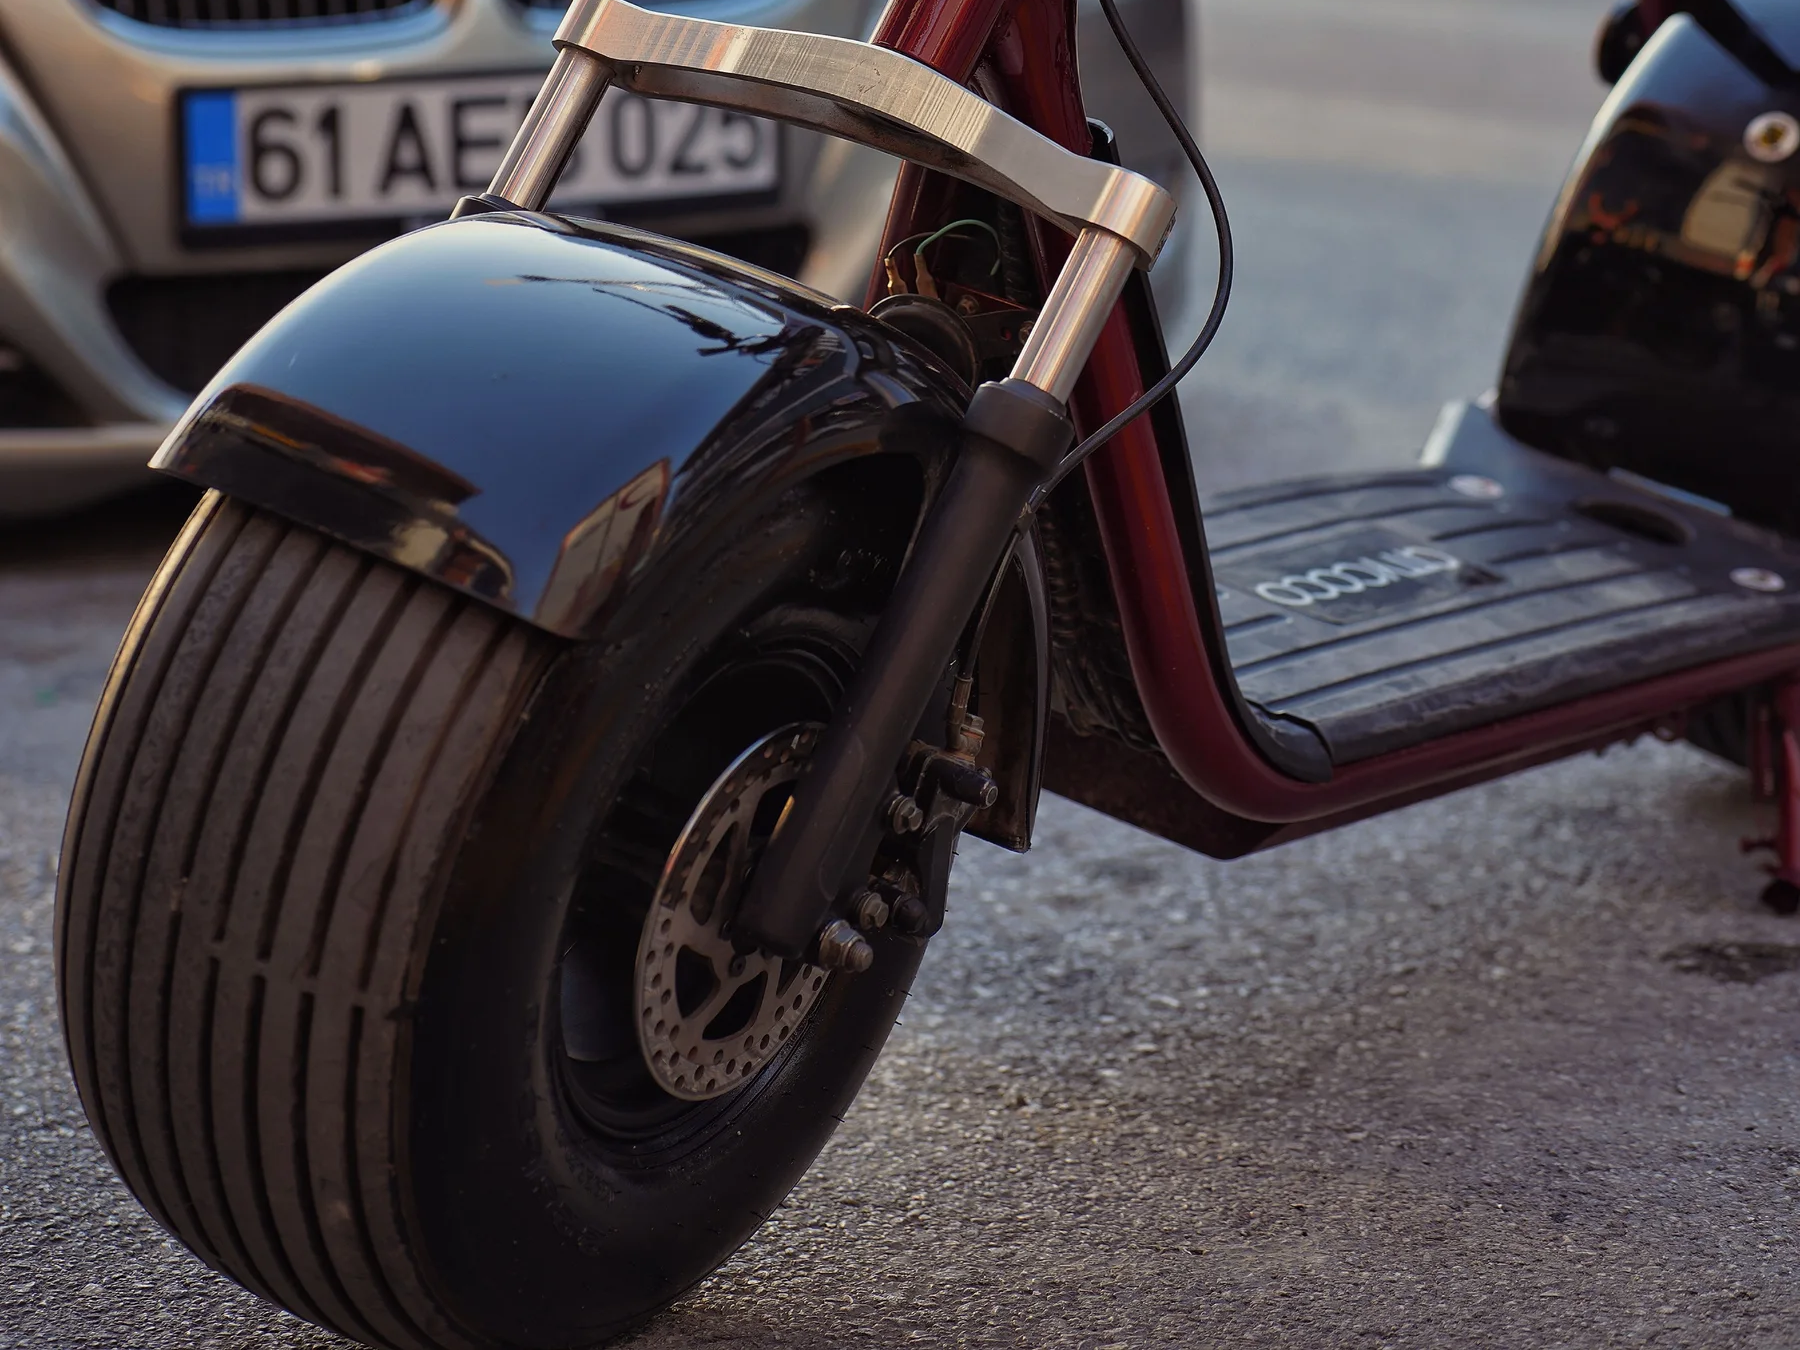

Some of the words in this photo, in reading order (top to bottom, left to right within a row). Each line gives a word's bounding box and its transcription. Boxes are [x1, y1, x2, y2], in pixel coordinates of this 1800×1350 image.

[247, 103, 345, 201] 61
[381, 96, 582, 193] AE
[609, 94, 764, 178] 025
